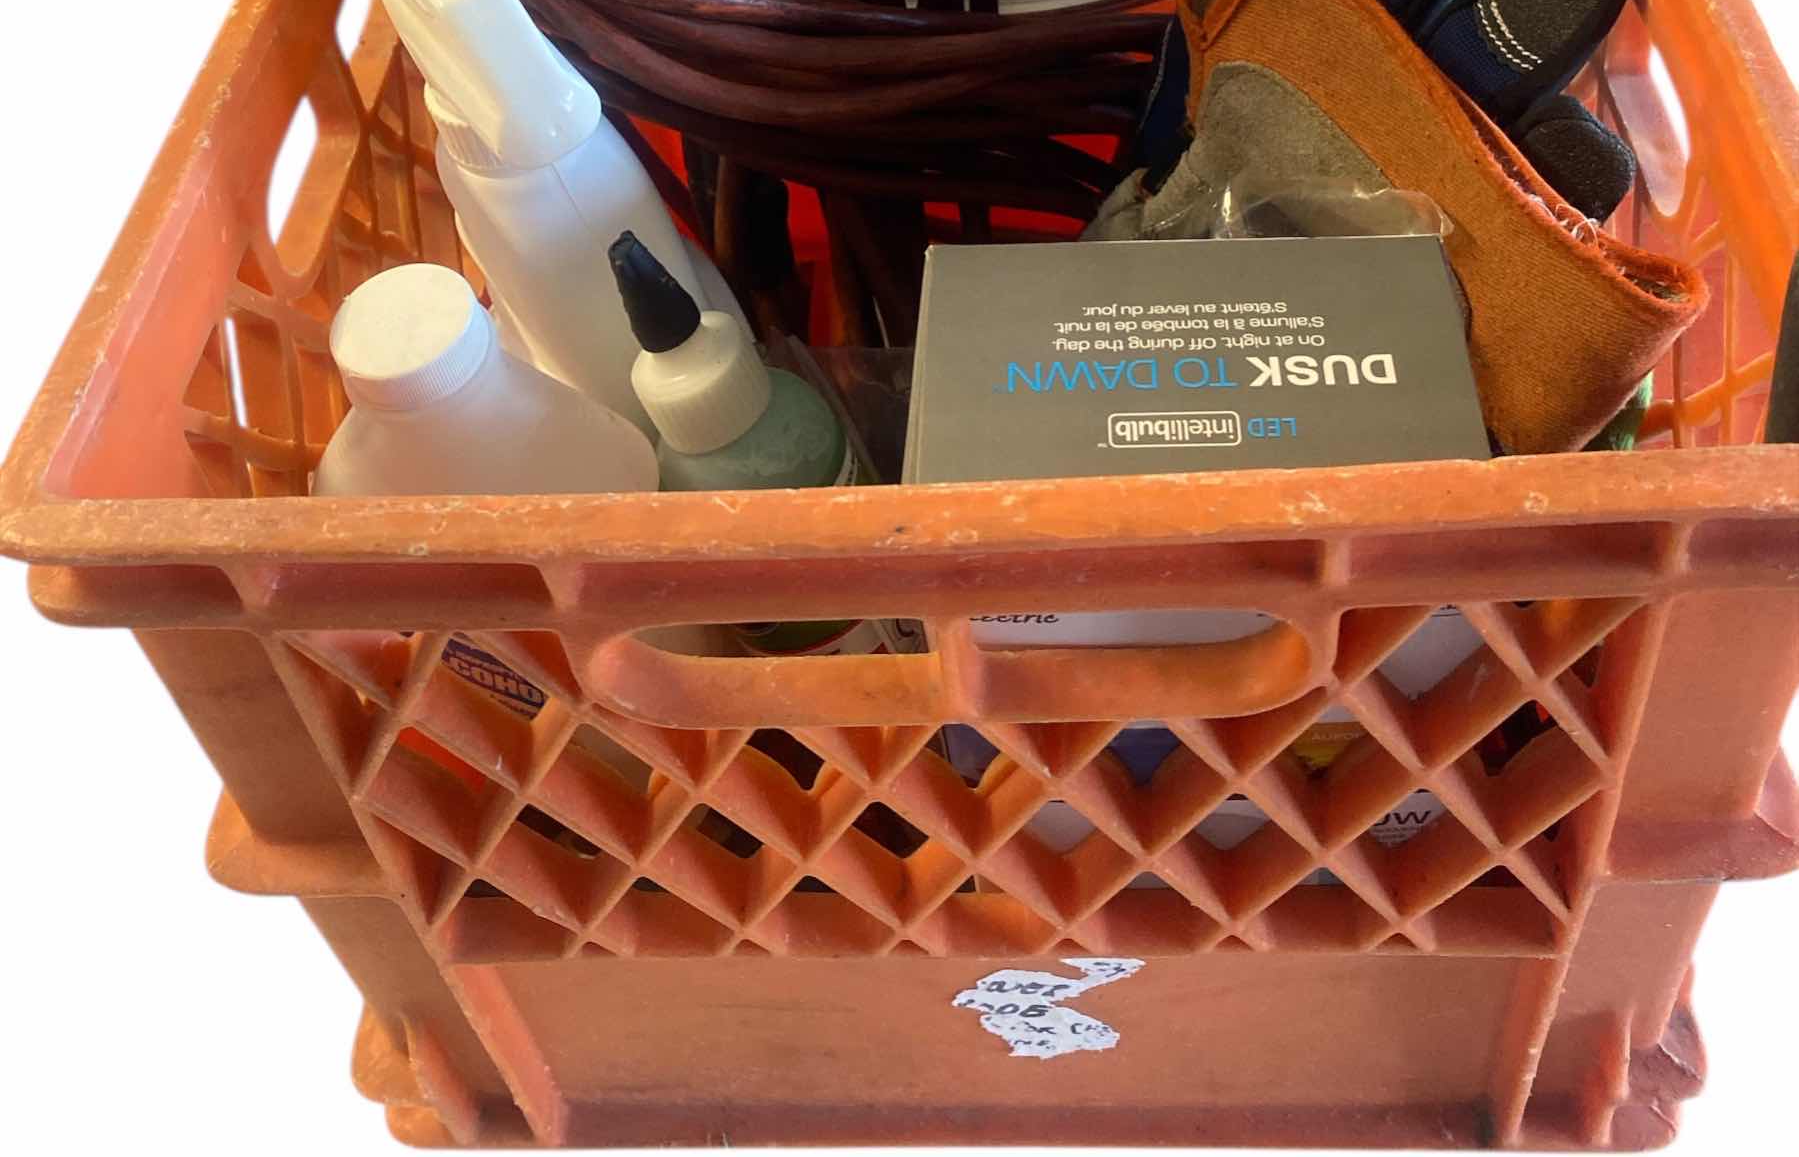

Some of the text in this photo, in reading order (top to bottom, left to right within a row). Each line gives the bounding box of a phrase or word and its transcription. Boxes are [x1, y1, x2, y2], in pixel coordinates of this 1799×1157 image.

[1082, 302, 1288, 317] S'éteint au lever du jour.
[1053, 316, 1325, 334] S'allume à la tombée de la nuit.
[1052, 333, 1325, 353] On at night. Off during the day.
[1006, 354, 1398, 394] DUSK TO DAWN
[1115, 417, 1298, 442] LED intellibulb
